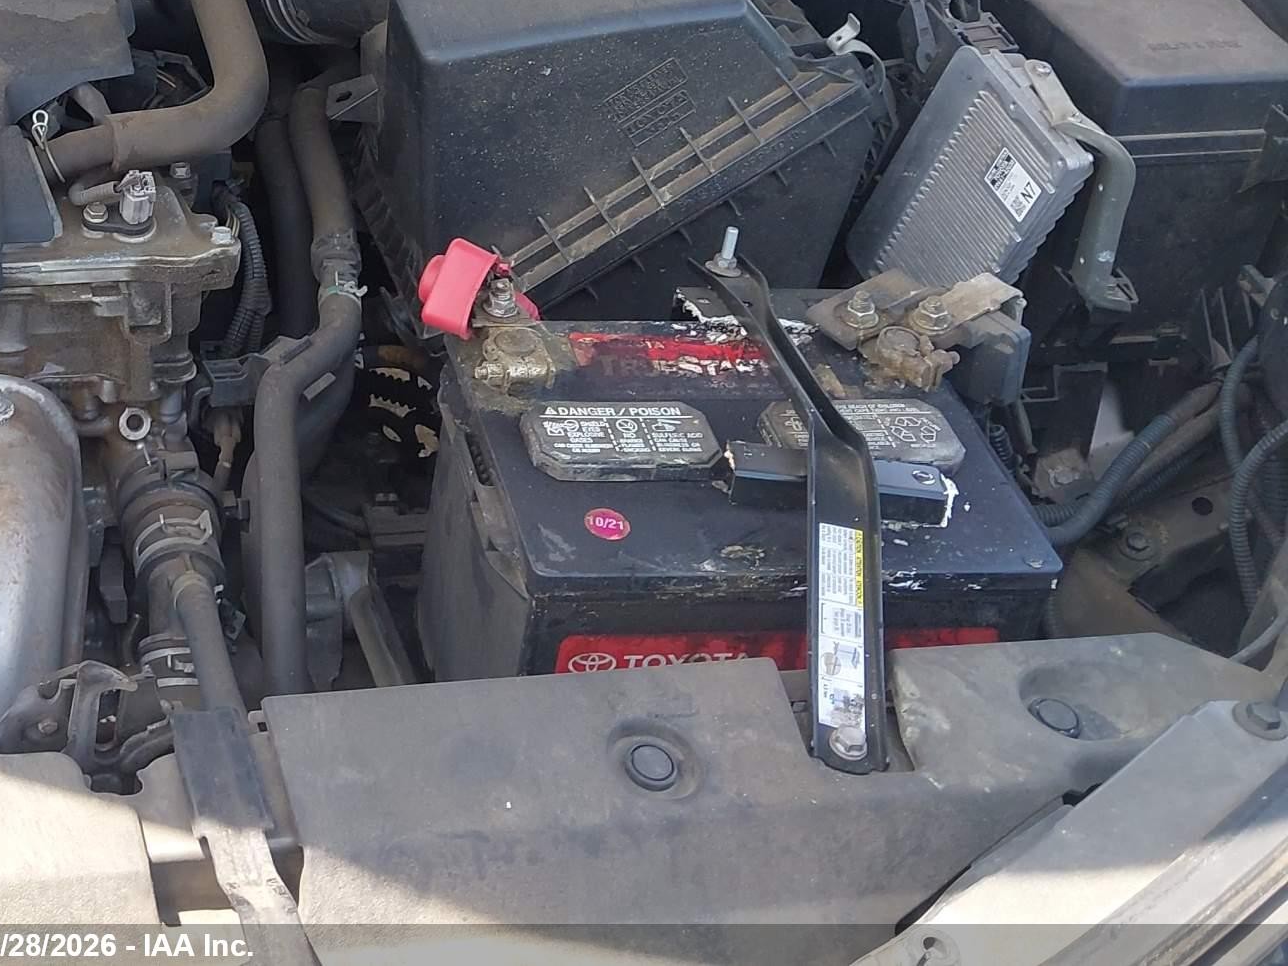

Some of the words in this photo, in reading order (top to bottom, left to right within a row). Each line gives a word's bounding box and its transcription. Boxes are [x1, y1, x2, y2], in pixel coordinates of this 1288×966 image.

[1020, 181, 1036, 204] N7
[558, 407, 616, 416] DANGER
[629, 407, 681, 416] POISON
[586, 515, 624, 530] 10/21
